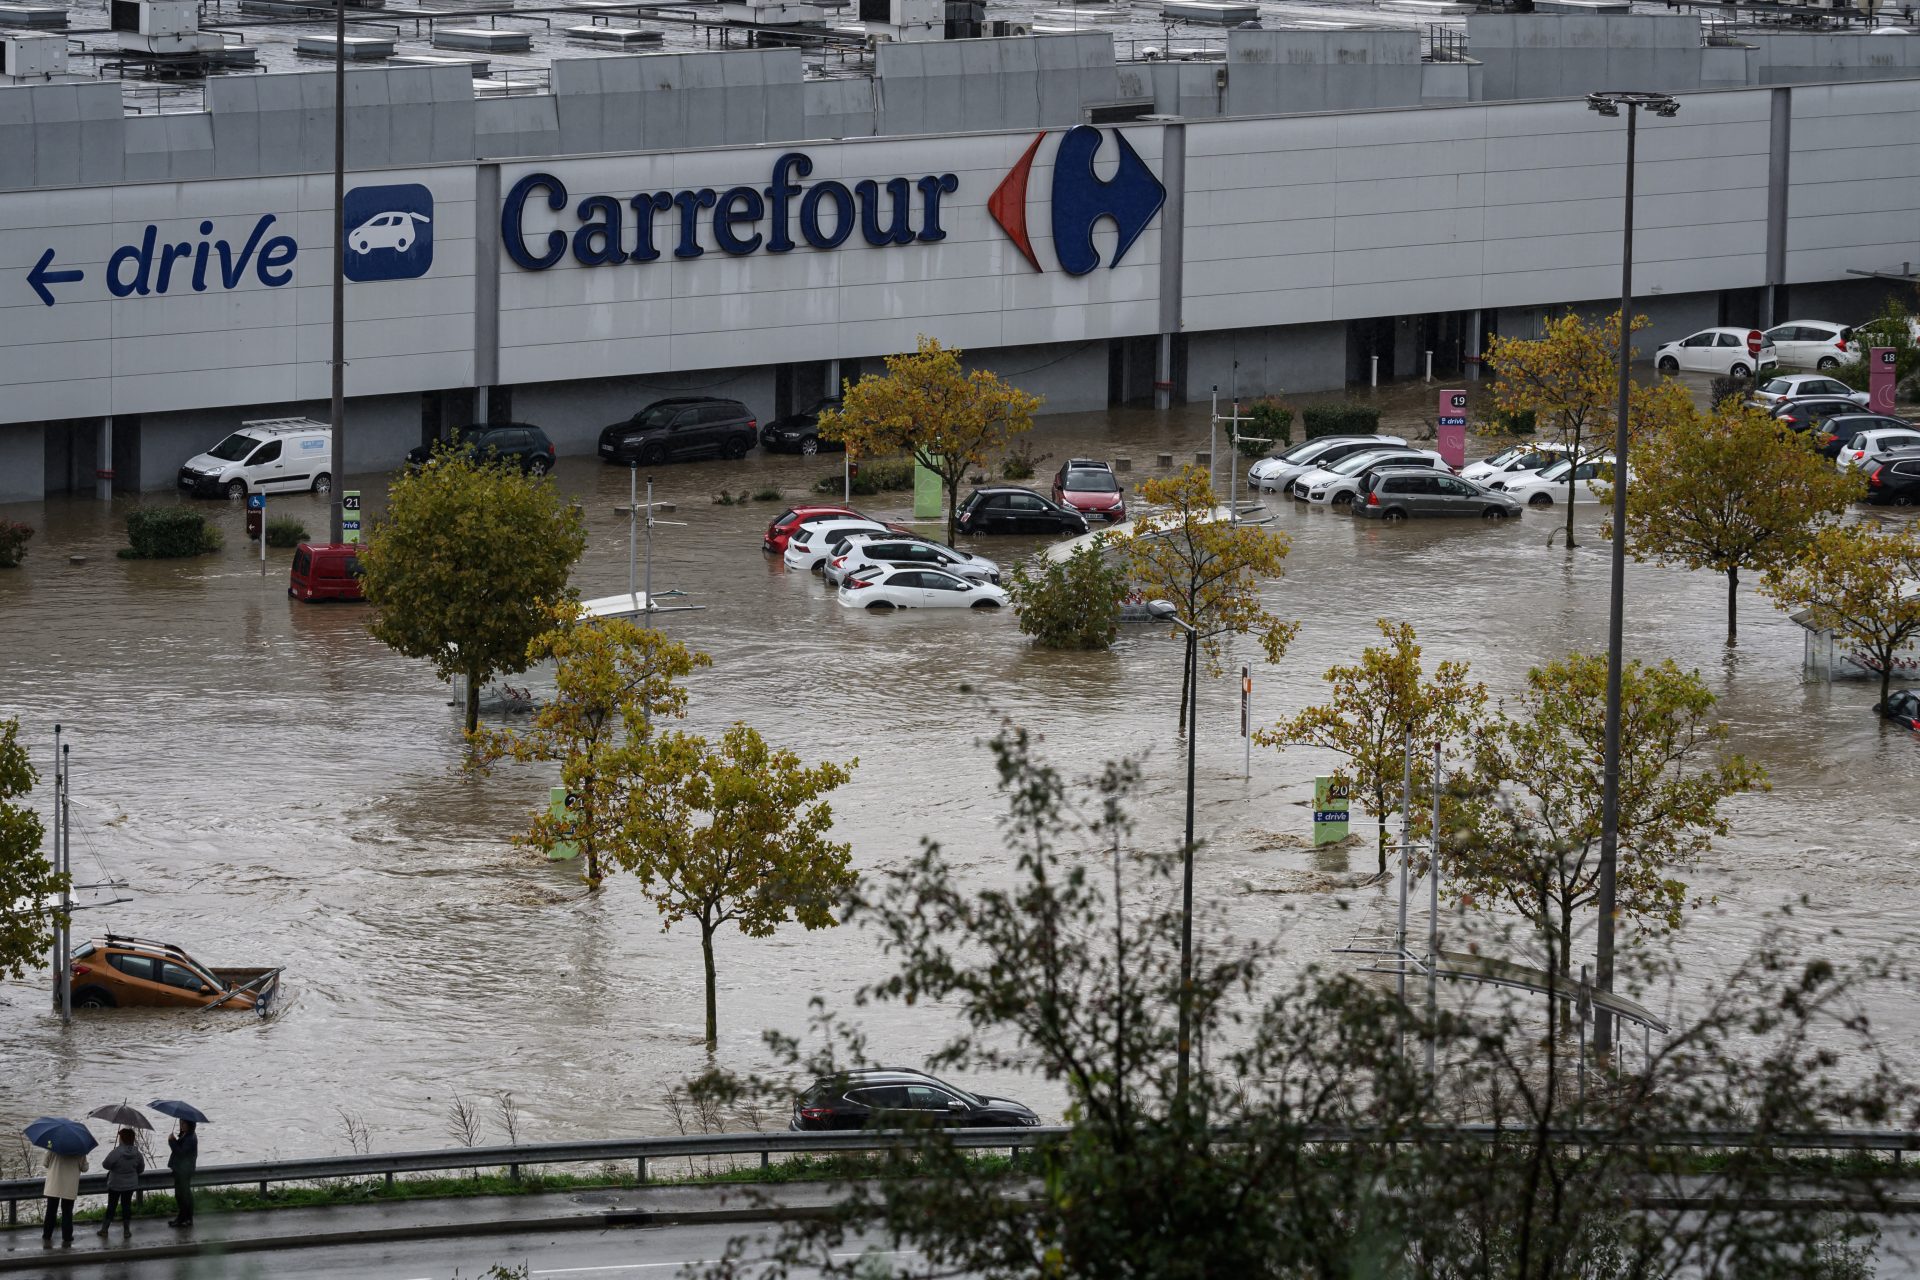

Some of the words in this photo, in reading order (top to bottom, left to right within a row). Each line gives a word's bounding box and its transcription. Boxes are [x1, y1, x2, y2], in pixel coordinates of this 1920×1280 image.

[501, 152, 959, 270] Carrefour
[106, 213, 298, 297] drive
[1884, 353, 1895, 362] 18
[1453, 396, 1465, 405] 19
[345, 498, 360, 508] 21
[1332, 785, 1348, 796] 20
[1325, 812, 1347, 821] drive
